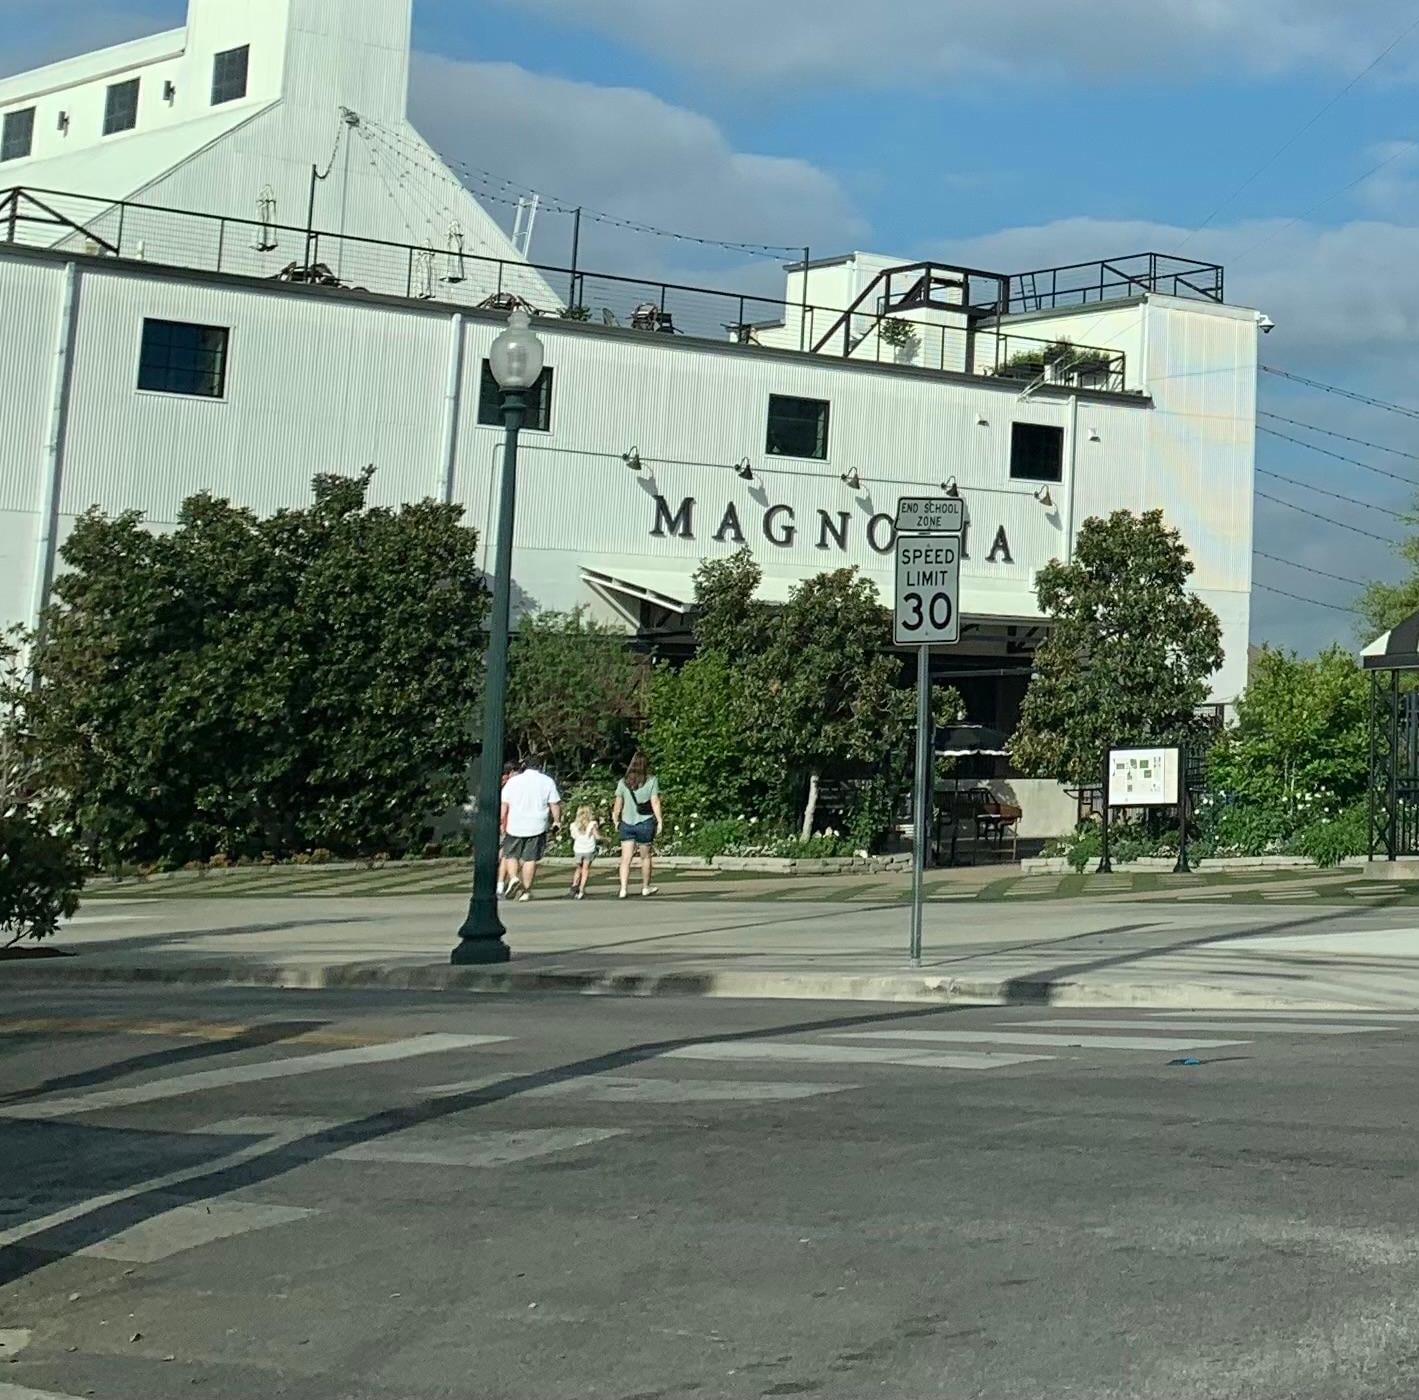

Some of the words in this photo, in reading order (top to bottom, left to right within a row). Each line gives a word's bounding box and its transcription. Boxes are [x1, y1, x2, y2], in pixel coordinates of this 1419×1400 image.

[901, 502, 919, 514] END
[923, 503, 959, 514] SCHOOL
[650, 495, 1014, 563] MAGNOIA
[916, 516, 942, 527] ZONE
[901, 549, 955, 565] SPEED
[906, 570, 948, 587] LIMIT
[901, 592, 952, 631] 30
